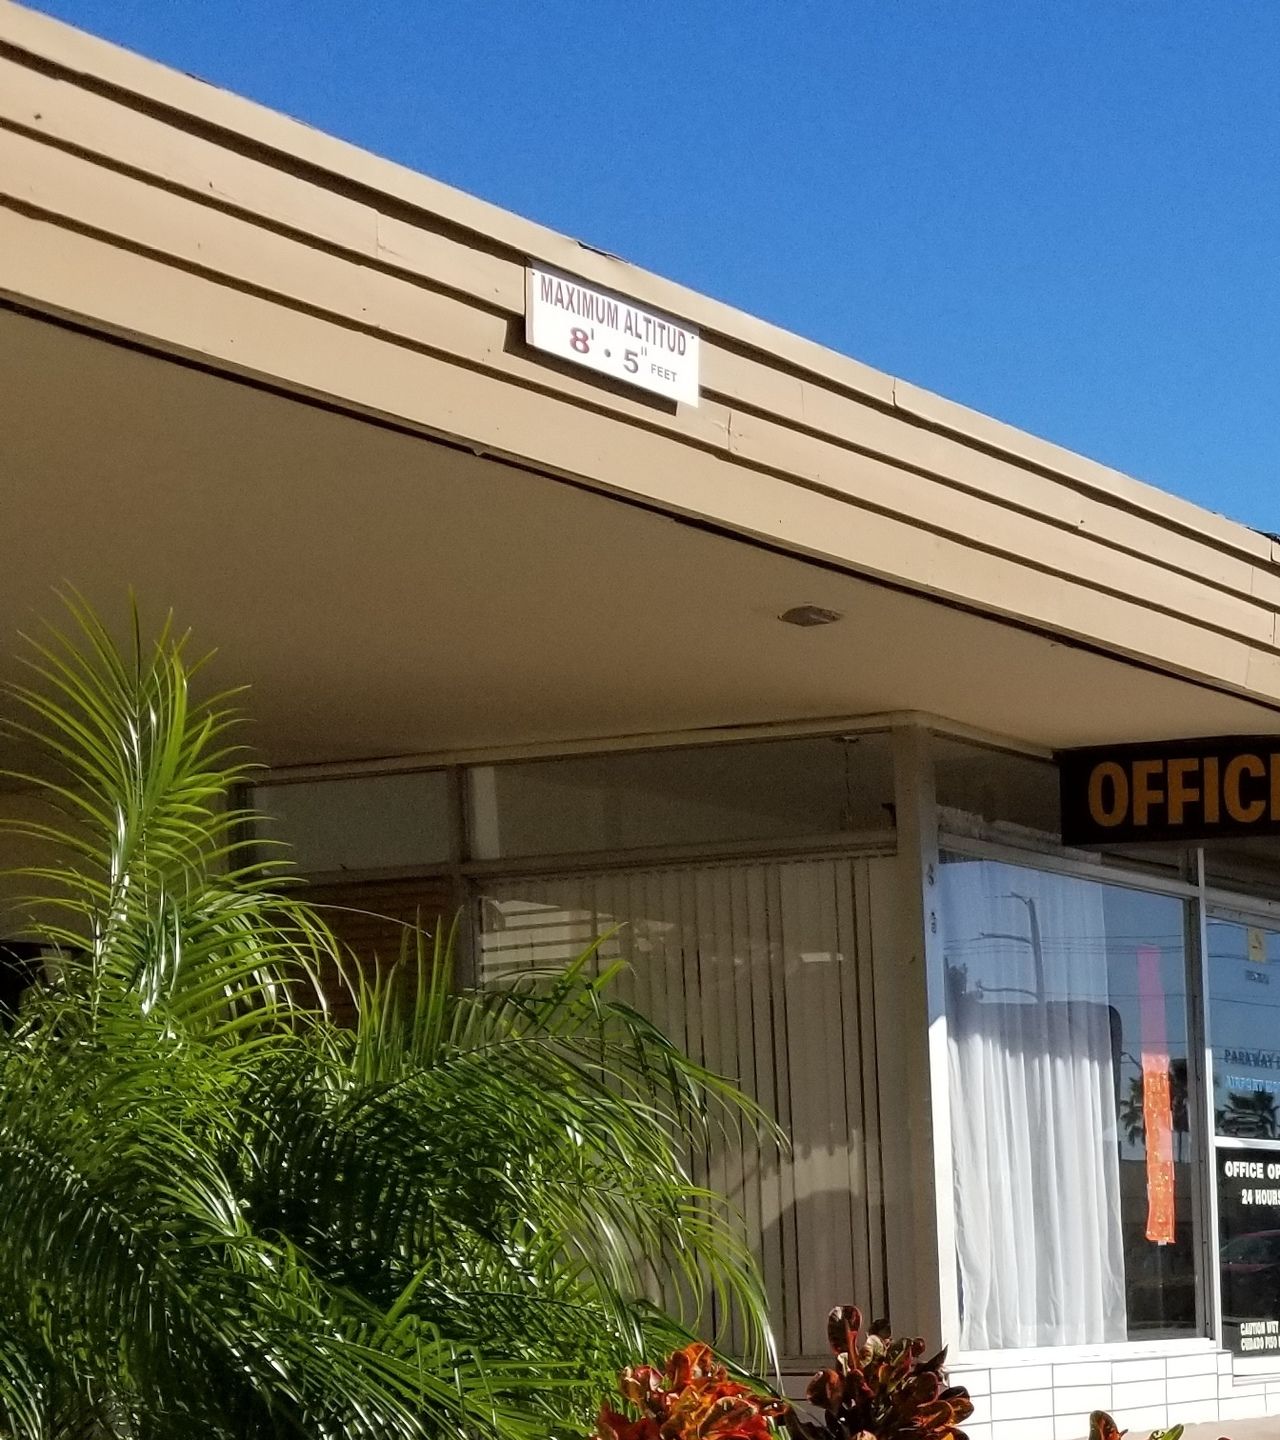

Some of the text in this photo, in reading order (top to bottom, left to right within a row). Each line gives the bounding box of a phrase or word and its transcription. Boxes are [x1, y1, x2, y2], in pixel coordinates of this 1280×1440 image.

[541, 274, 687, 356] MAXIMUM ALTITUD
[651, 363, 678, 382] FEET
[1225, 1161, 1264, 1180] OFFICE
[1241, 1188, 1253, 1205] 24
[1240, 1321, 1265, 1336] CAUTION
